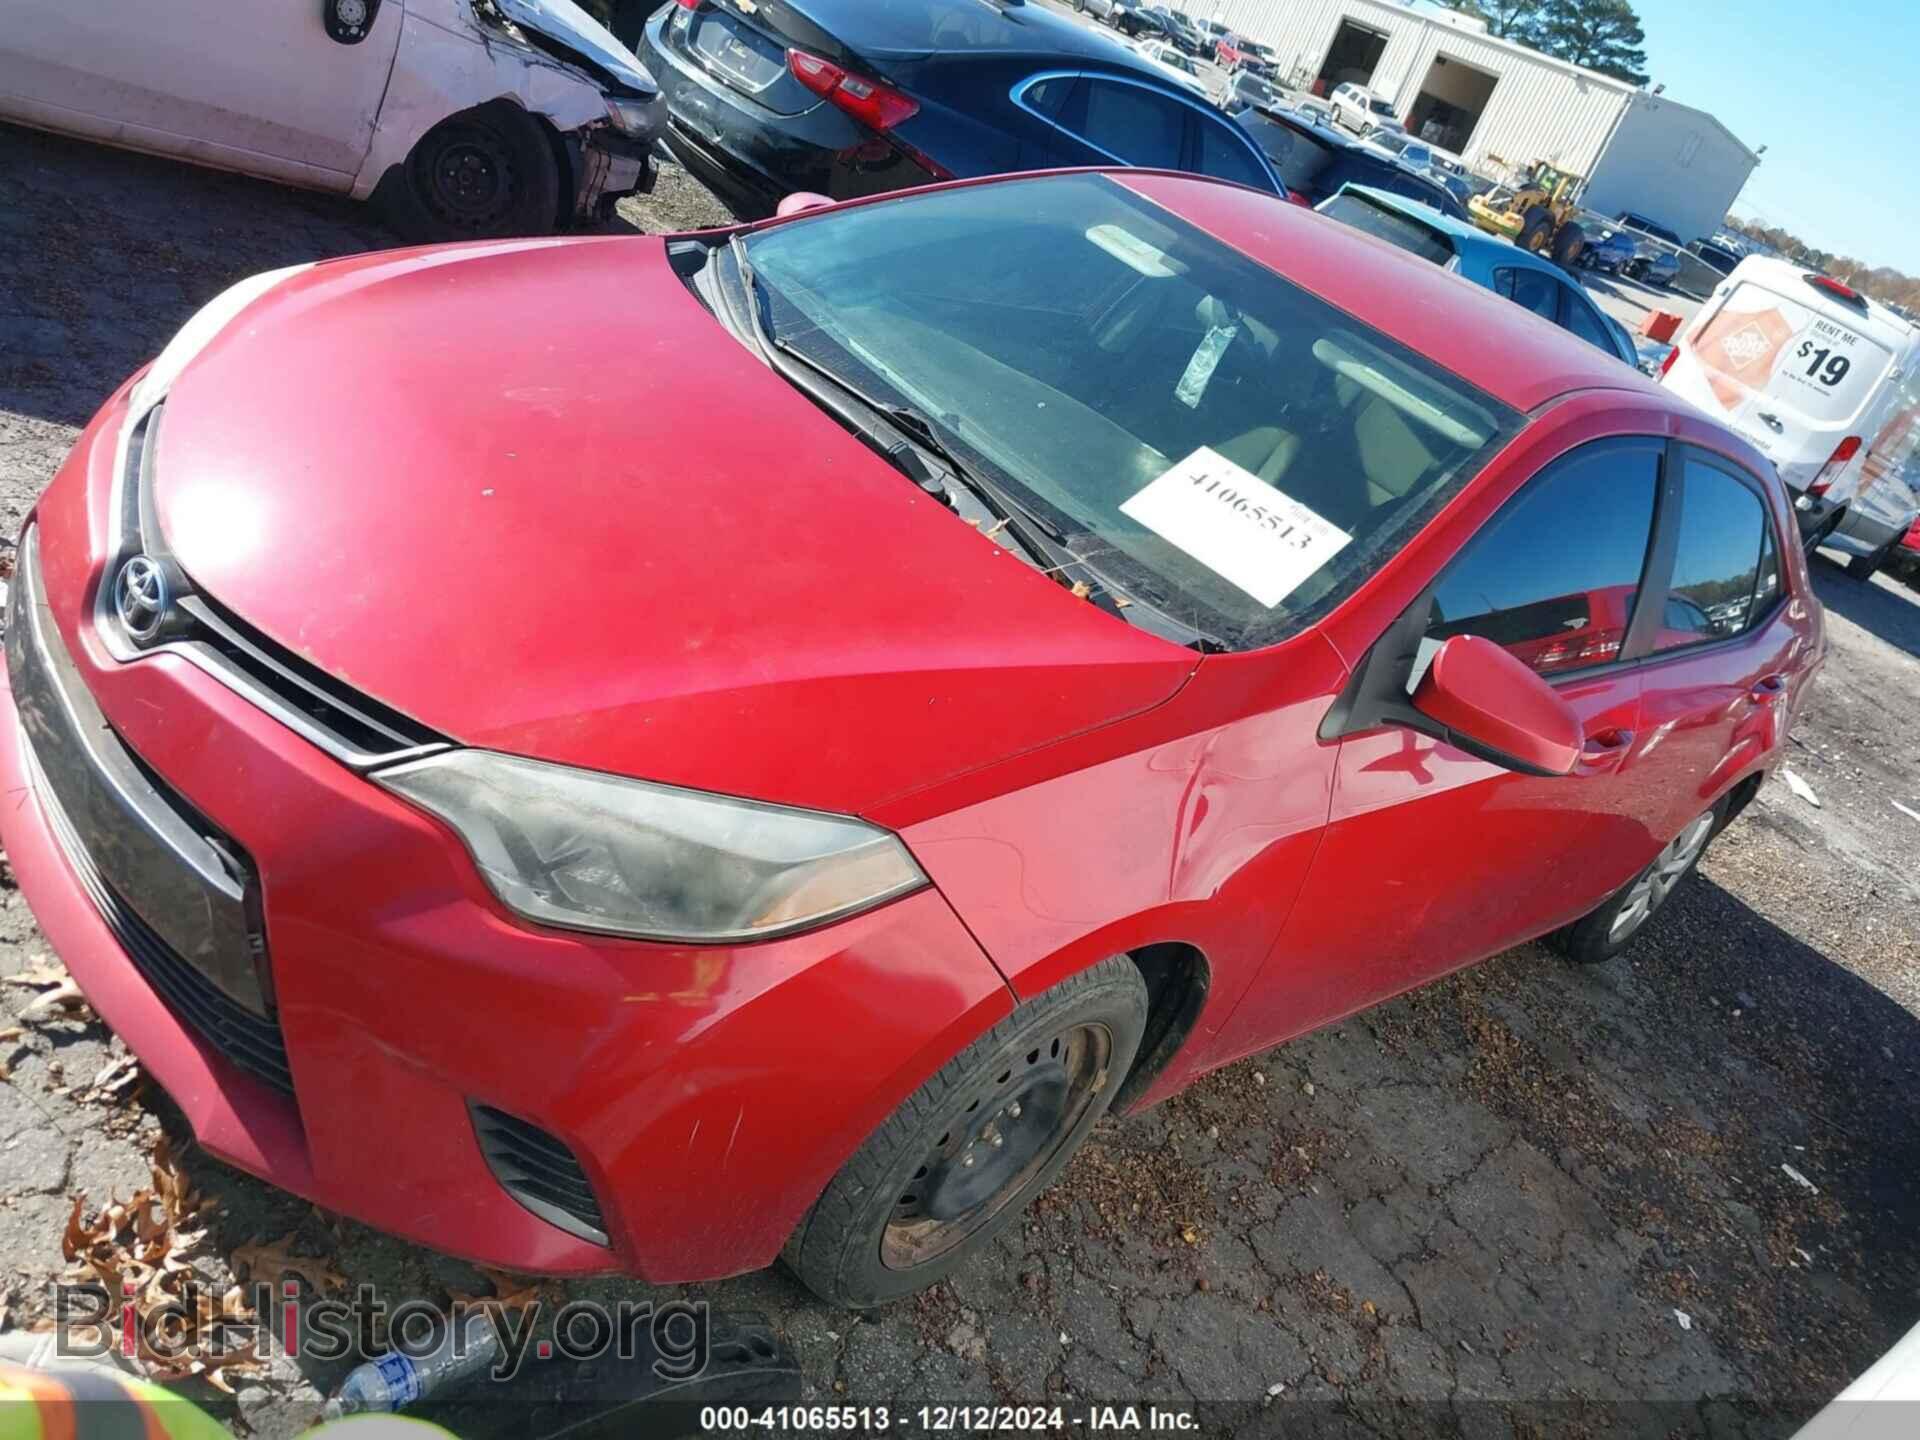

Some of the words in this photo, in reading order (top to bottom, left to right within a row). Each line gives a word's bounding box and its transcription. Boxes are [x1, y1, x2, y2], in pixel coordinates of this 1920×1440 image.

[1815, 319, 1842, 338] RENT
[1840, 332, 1859, 347] ME
[1797, 340, 1851, 387] $19
[1188, 472, 1313, 550] 41065513
